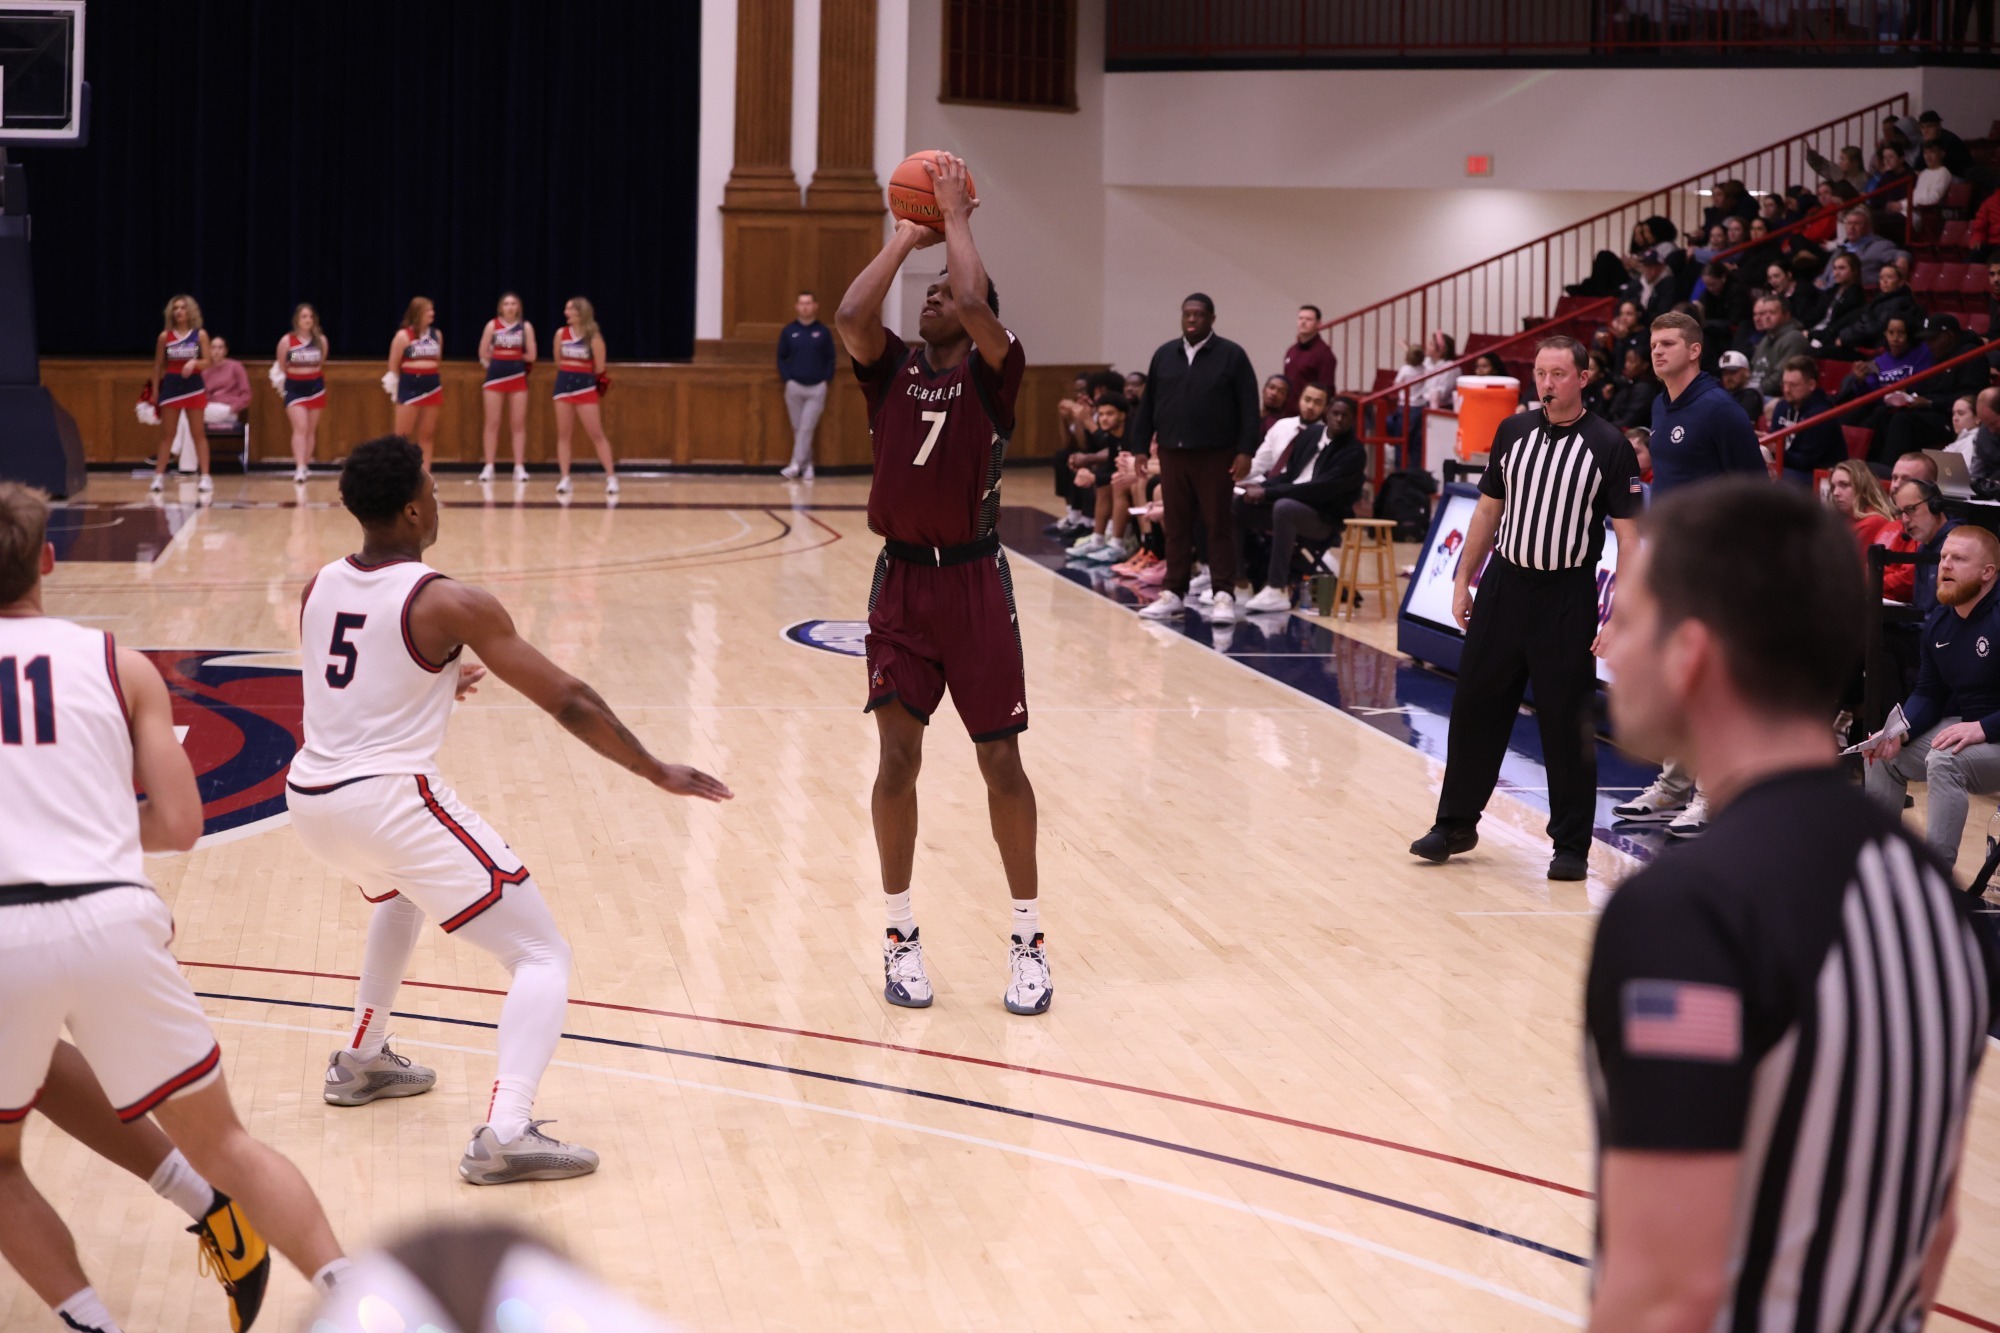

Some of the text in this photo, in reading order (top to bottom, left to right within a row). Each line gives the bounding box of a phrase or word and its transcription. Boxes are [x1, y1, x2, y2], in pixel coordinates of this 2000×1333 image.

[912, 411, 947, 466] 7
[324, 612, 367, 689] 5
[0, 655, 56, 745] 11
